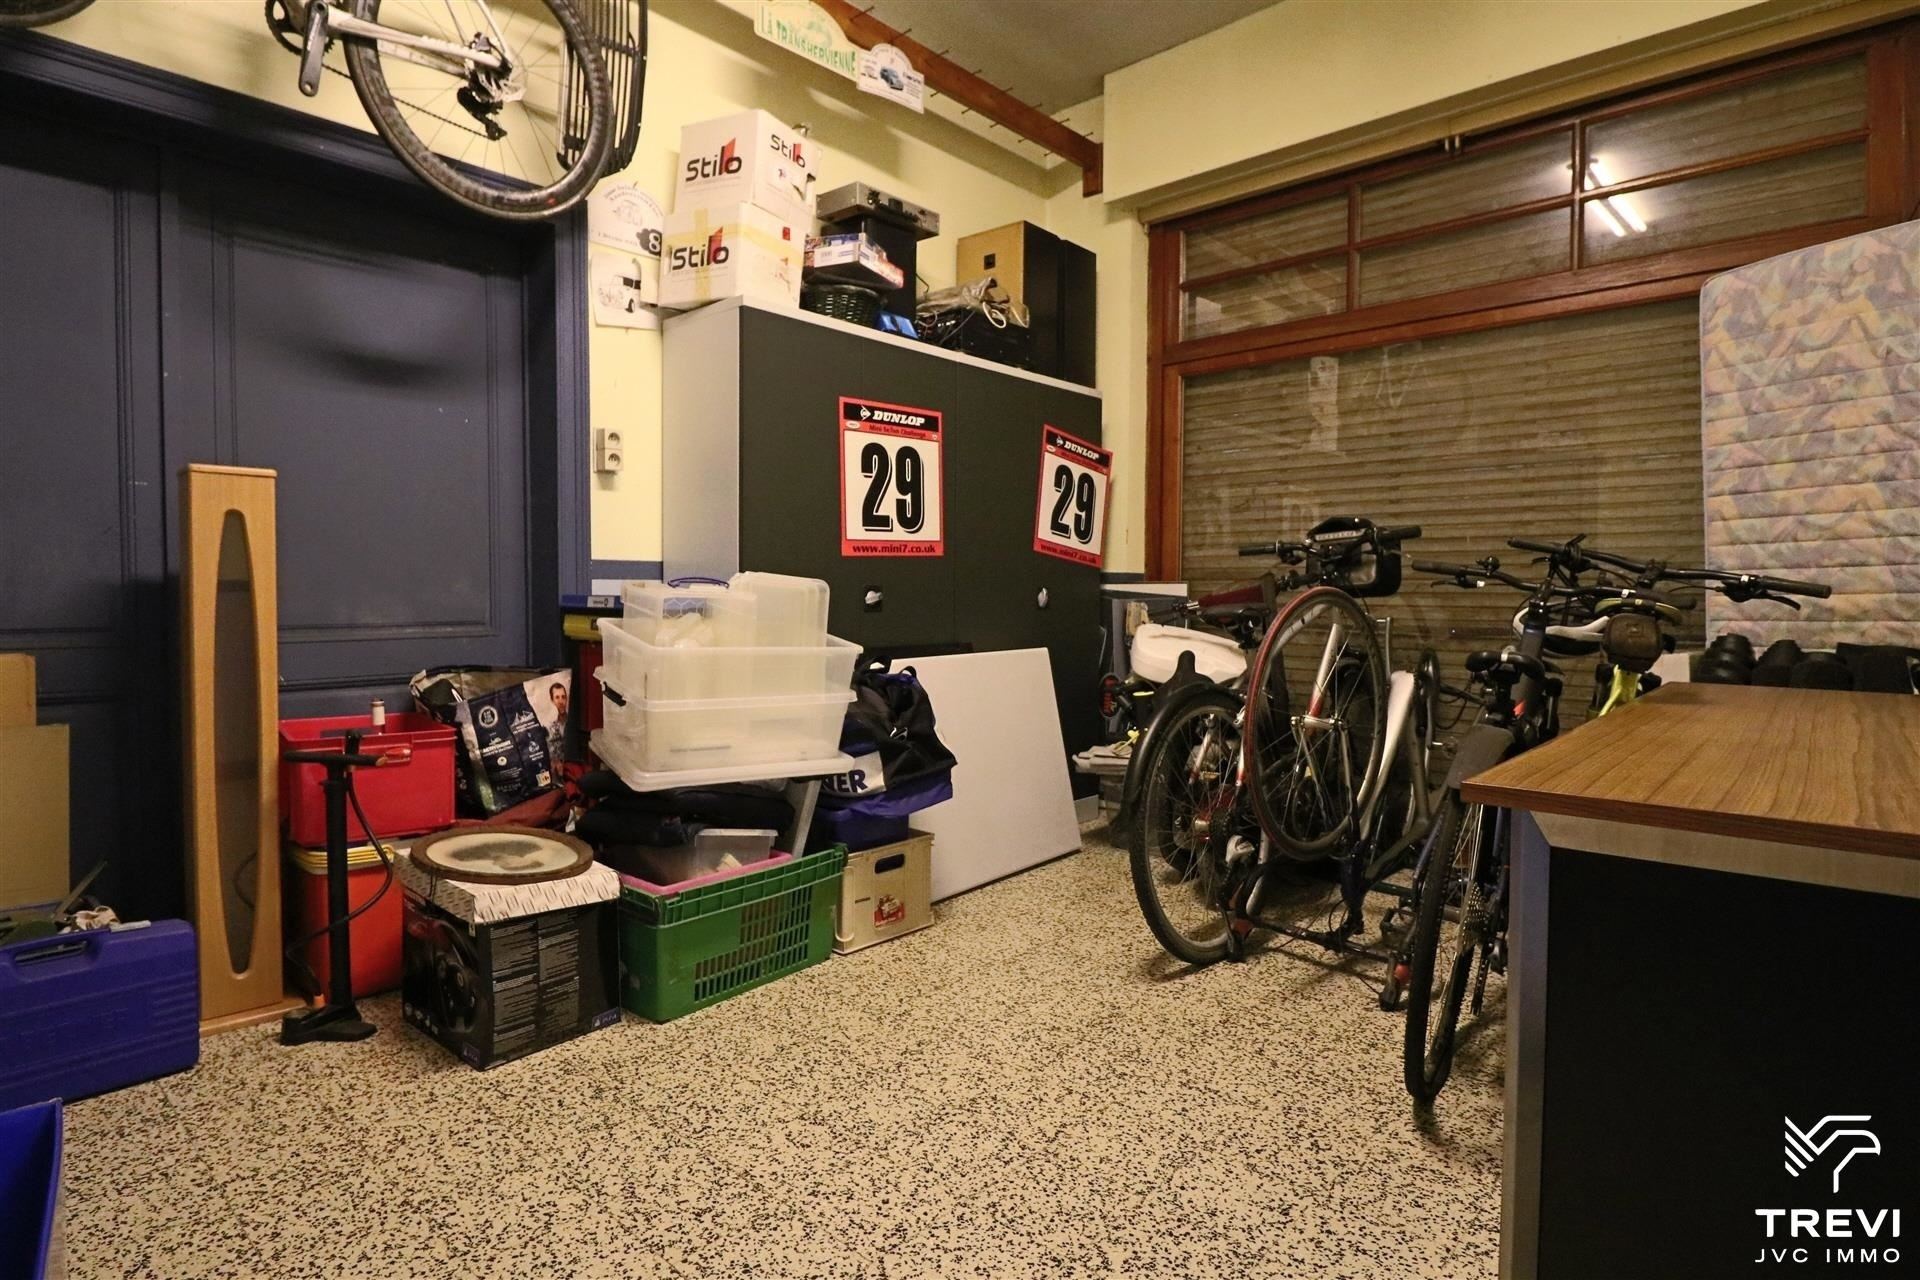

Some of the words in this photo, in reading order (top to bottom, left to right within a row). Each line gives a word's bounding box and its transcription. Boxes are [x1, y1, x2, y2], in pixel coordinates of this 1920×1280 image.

[685, 138, 742, 182] Stilo
[770, 134, 806, 168] Stilo
[672, 227, 730, 271] Stilo
[872, 410, 926, 427] DUNLOP
[1064, 440, 1100, 461] DUNLOP
[861, 442, 925, 534] 29
[1050, 464, 1097, 545] 29
[852, 543, 936, 553] www.mini7.co.uk
